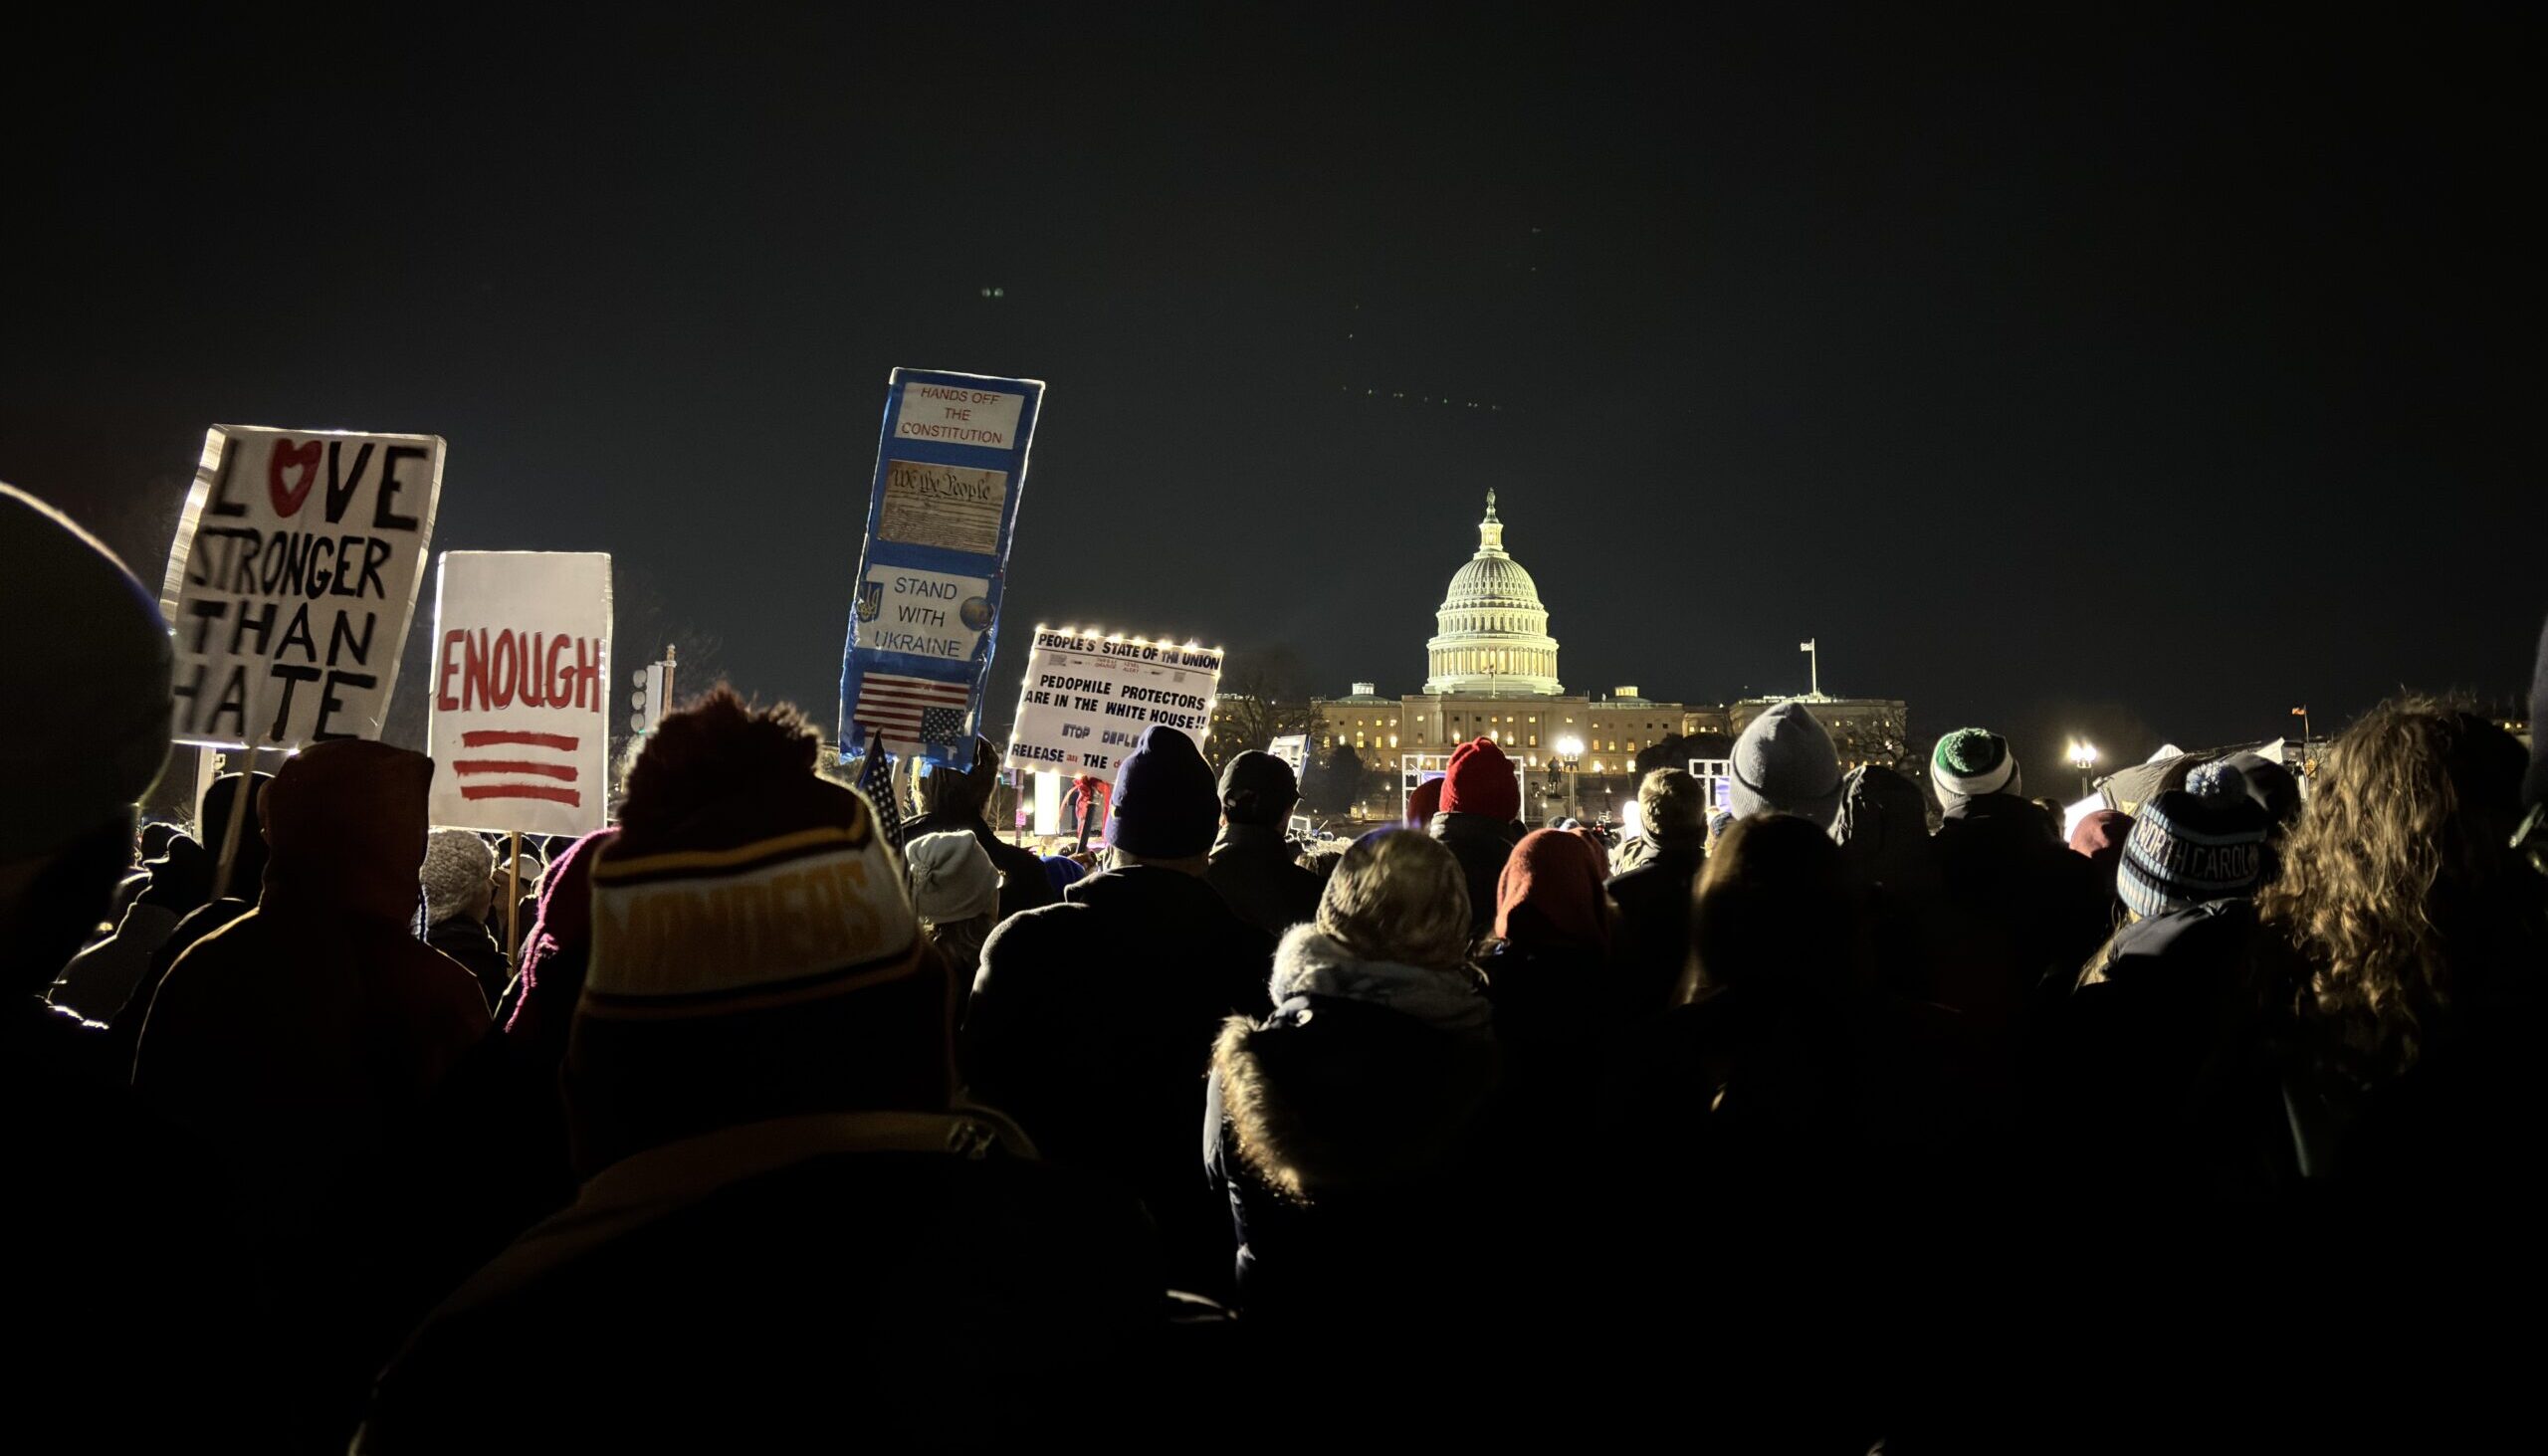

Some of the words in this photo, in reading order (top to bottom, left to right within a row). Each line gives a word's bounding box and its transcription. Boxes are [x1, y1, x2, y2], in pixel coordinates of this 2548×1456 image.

[921, 387, 967, 402] HANDS
[971, 392, 1000, 405] OFF
[945, 407, 971, 421] THE
[901, 422, 1003, 444] CONSTITUTION
[210, 436, 429, 531] LOVE
[892, 469, 918, 489] We
[921, 471, 940, 494] the
[940, 473, 990, 502] People
[186, 524, 392, 600] STRONGER
[894, 576, 957, 600] STAND
[188, 597, 376, 666] THAN
[898, 605, 947, 627] WITH
[875, 630, 962, 658] UKRAINE
[1038, 633, 1096, 653] PEOPLE'S
[1102, 641, 1140, 659] STATE
[1143, 647, 1158, 660] OF
[1181, 652, 1220, 670] UNION
[437, 628, 601, 712] ENOUGH
[1039, 674, 1112, 695] PEDOPHILE
[1121, 685, 1206, 711] PROTECTORS
[1024, 690, 1051, 707] ARE
[1054, 694, 1068, 708] IN
[1074, 697, 1098, 713] THE
[1105, 701, 1147, 721] WHITE
[1149, 708, 1207, 730] HOUSE!!
[1061, 724, 1091, 739] STOP
[1011, 743, 1065, 763] RELEASE
[1082, 753, 1109, 770] THE
[2134, 814, 2189, 875] NORTH
[2190, 843, 2254, 880] CAROL
